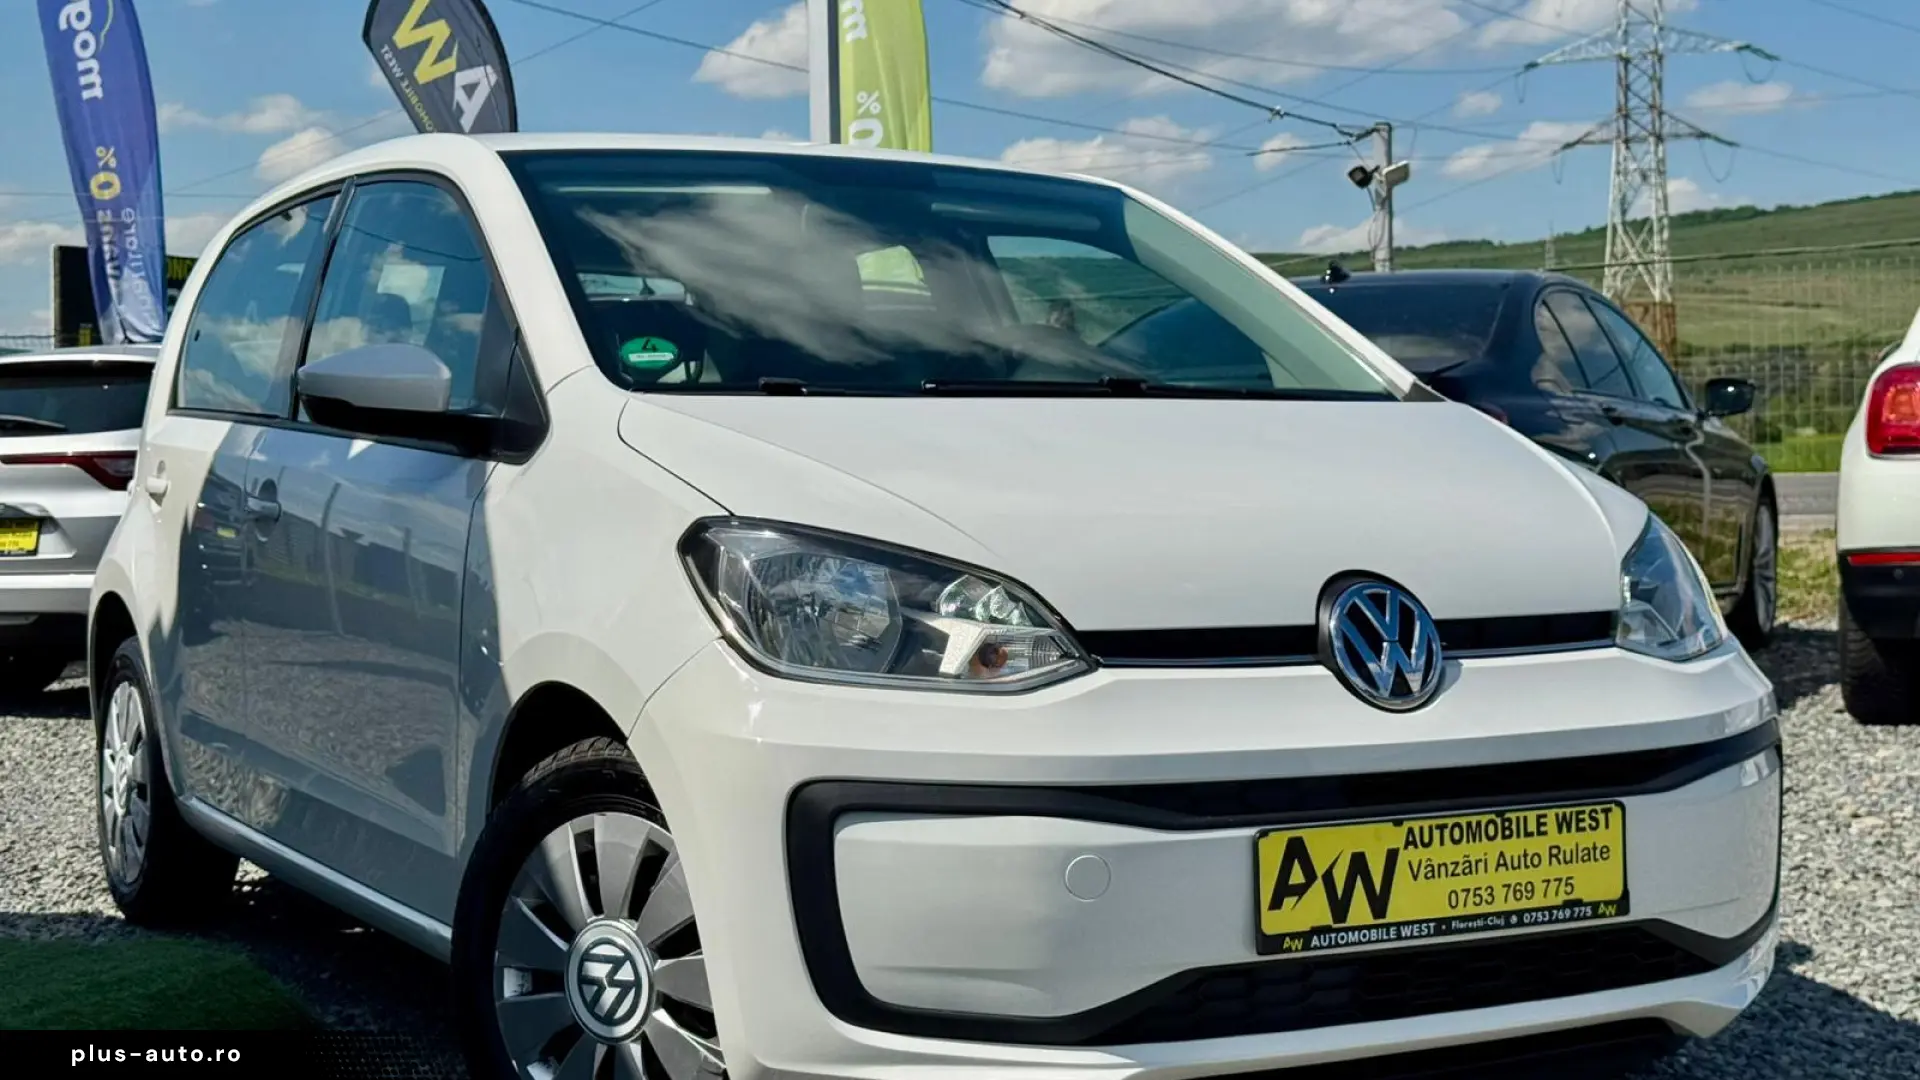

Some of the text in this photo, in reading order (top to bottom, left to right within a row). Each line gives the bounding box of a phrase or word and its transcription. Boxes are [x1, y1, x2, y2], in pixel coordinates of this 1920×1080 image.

[641, 337, 658, 352] 4
[1403, 807, 1613, 850] AUTOMOBILE WEST
[1495, 849, 1542, 873] Auto
[1549, 841, 1611, 867] Rulate
[1267, 836, 1400, 925] AW
[1448, 876, 1575, 910] 0753 769 775
[1310, 927, 1397, 948] AUTOMOBILE
[1400, 922, 1436, 938] WEST
[1523, 909, 1549, 924] 0753
[1551, 907, 1570, 920] 769
[1573, 905, 1592, 918] 775
